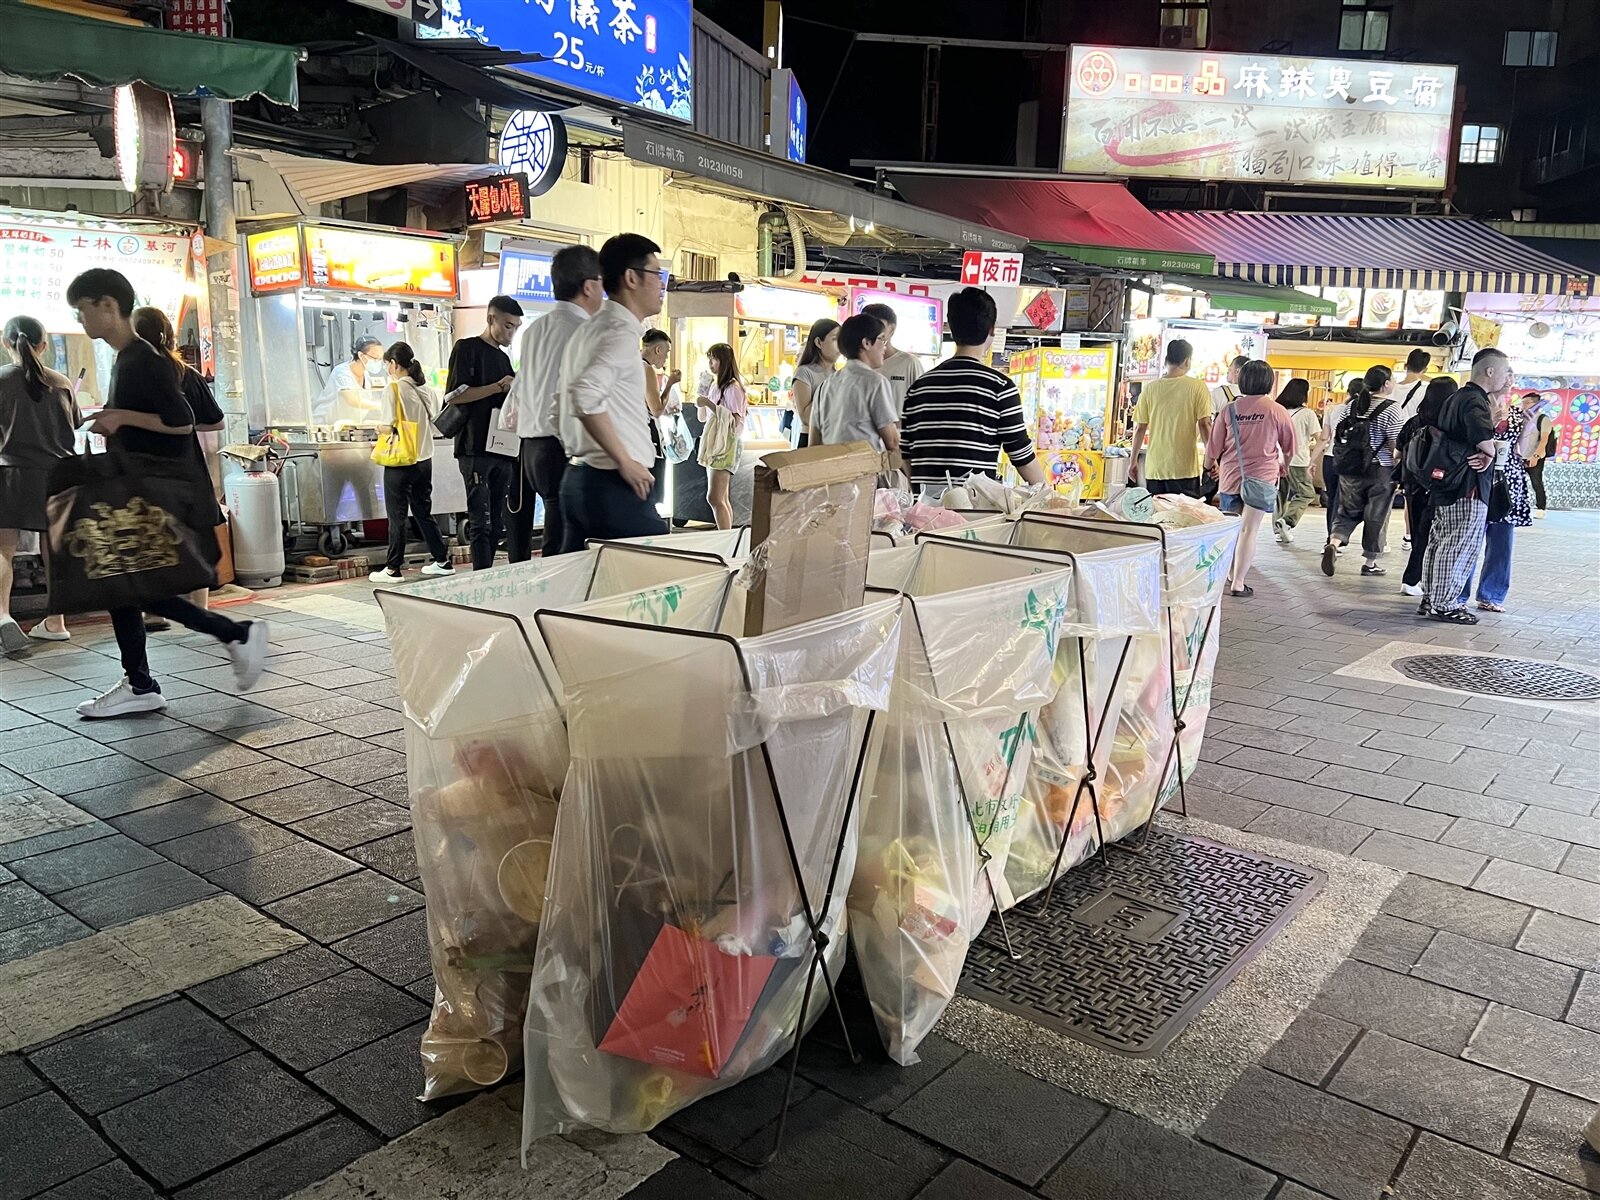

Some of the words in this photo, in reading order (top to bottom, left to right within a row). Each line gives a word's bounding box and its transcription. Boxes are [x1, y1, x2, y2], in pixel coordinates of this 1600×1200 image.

[552, 31, 585, 70] 25
[585, 61, 605, 77] 元/杯
[1233, 62, 1444, 108] 麻辣臭豆腐
[645, 140, 685, 163] 石牌帆布
[698, 155, 743, 179] 28230058
[468, 181, 521, 217] 大腸包小腸
[70, 236, 112, 251] 士林
[144, 240, 177, 253] 基河
[49, 248, 64, 258] 50
[982, 256, 1020, 283] 夜市
[1161, 260, 1201, 270] 28230058
[47, 277, 61, 287] 50
[404, 282, 415, 291] 70
[47, 291, 61, 301] 50
[1047, 352, 1070, 364] TOY
[1071, 353, 1106, 365] STORY
[1235, 413, 1265, 421] Newtro
[1105, 900, 1154, 931] CATV
